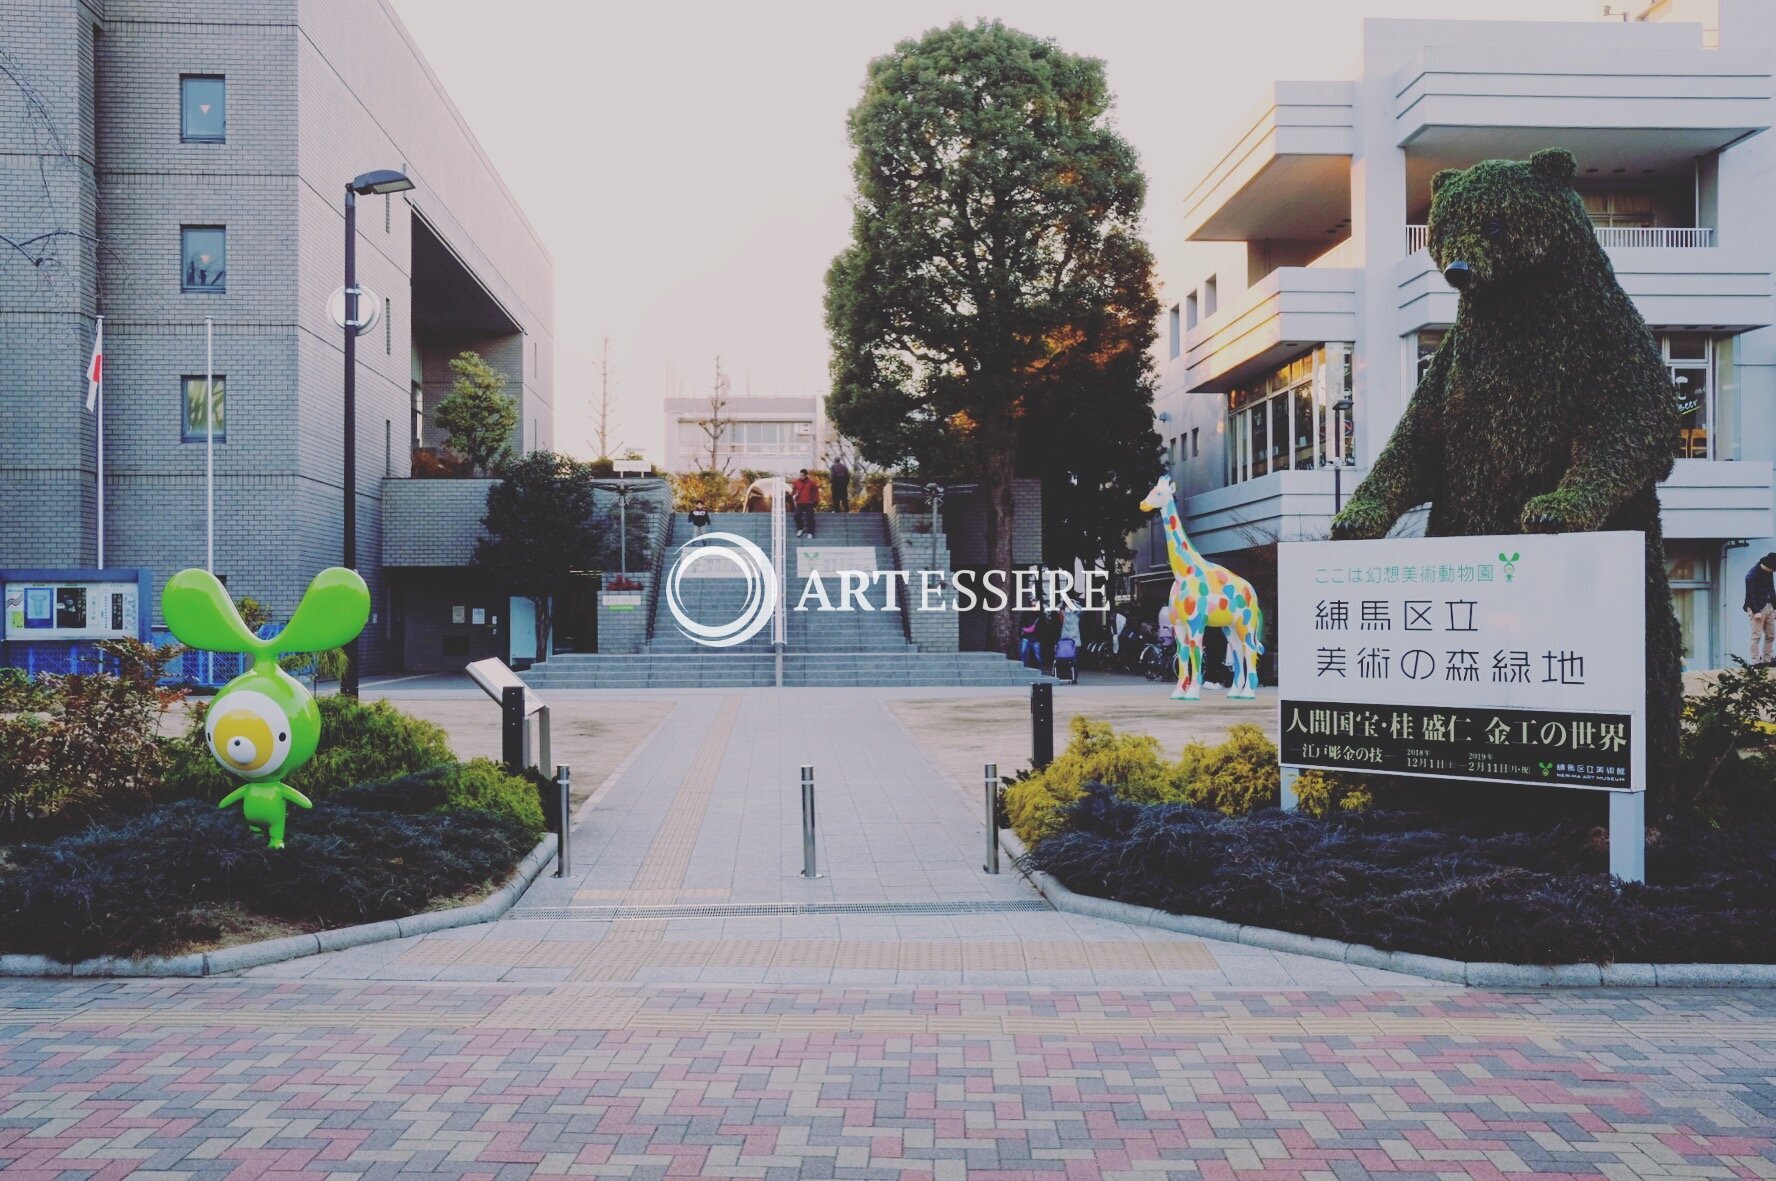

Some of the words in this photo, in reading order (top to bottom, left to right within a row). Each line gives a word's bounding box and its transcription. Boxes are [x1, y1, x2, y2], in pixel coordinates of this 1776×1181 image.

[1314, 564, 1494, 584] ここは幻想美術動物園
[1315, 599, 1479, 631] 練馬区立
[1316, 646, 1585, 685] 美術の森緑地
[1484, 716, 1627, 752] 金工の世界
